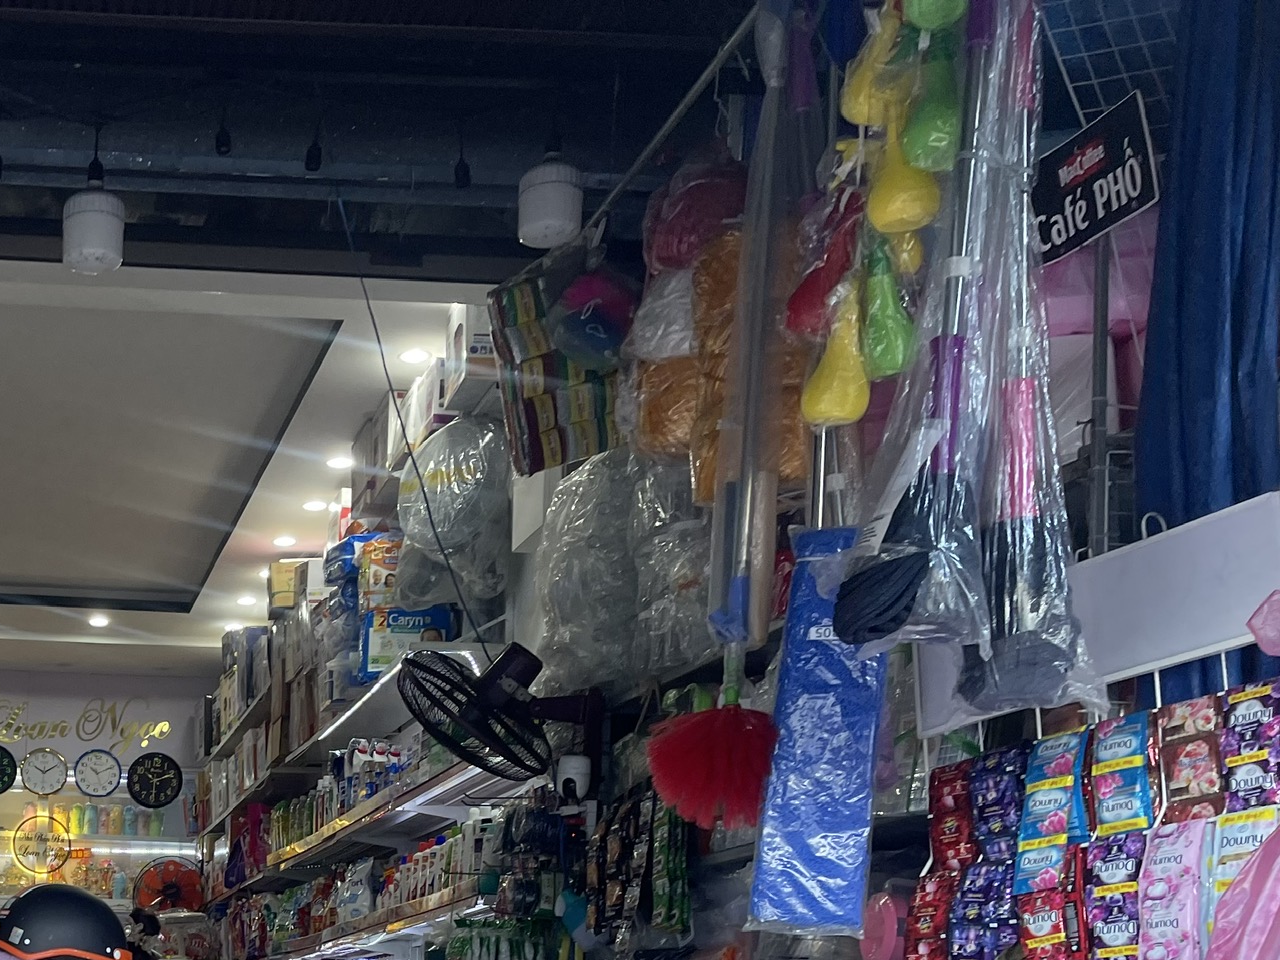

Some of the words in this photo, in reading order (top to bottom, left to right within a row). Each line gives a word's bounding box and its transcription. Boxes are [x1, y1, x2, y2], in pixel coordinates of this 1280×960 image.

[1034, 189, 1090, 253] Café
[389, 614, 424, 629] Caryn
[1229, 705, 1273, 724] Downy
[76, 698, 171, 752] Ngọc
[1099, 738, 1132, 750] Downy
[1230, 773, 1274, 792] Downy
[1100, 800, 1133, 812] Downy
[1221, 833, 1263, 850] Downy
[1022, 853, 1053, 866] Downy
[1093, 858, 1135, 875] Downy
[1149, 854, 1183, 866] Downy
[1022, 911, 1057, 926] Downy
[1146, 917, 1179, 929] Downy
[1093, 921, 1137, 936] Downy
